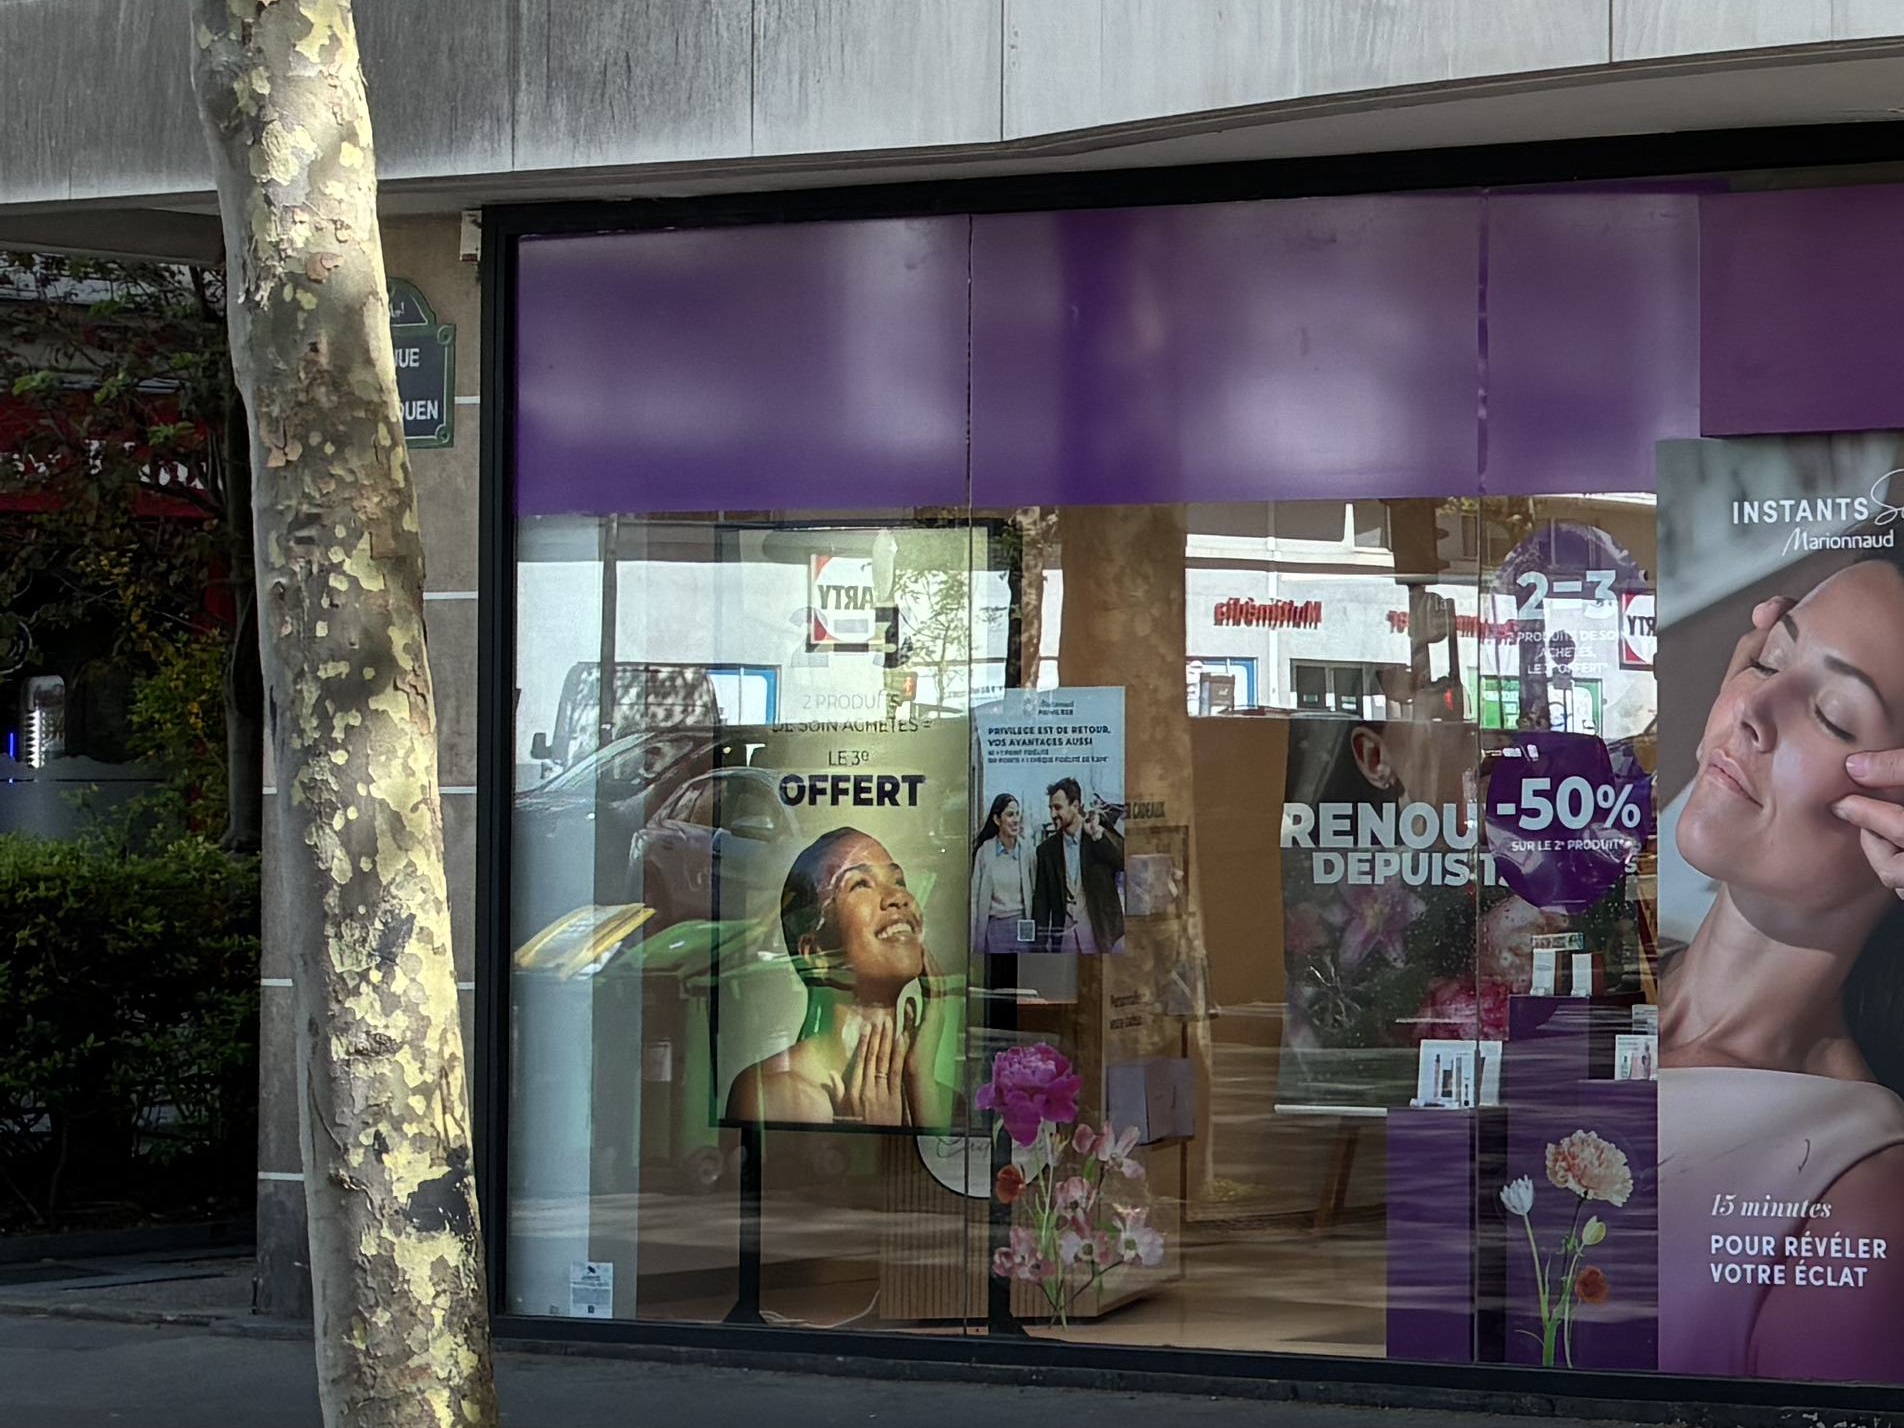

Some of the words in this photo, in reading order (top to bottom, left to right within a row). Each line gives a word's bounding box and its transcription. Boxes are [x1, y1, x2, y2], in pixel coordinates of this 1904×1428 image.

[1732, 498, 1869, 524] INSTANTS
[1782, 527, 1894, 556] Marionnaud
[987, 738, 1007, 747] VOS
[828, 751, 848, 766] LE
[779, 774, 928, 807] OFFERT
[1496, 776, 1642, 832] -50%
[1280, 802, 1482, 849] RENOU
[1511, 840, 1536, 853] SUR
[1538, 840, 1551, 852] LE
[1312, 852, 1468, 887] DEPUIS
[1711, 1193, 1737, 1217] 15
[1740, 1194, 1832, 1218] minutes
[1710, 1234, 1776, 1257] POUR
[1784, 1230, 1888, 1259] RÉVÉLER
[1710, 1262, 1786, 1285] VOTRE
[1794, 1259, 1868, 1287] ÉCLAT
